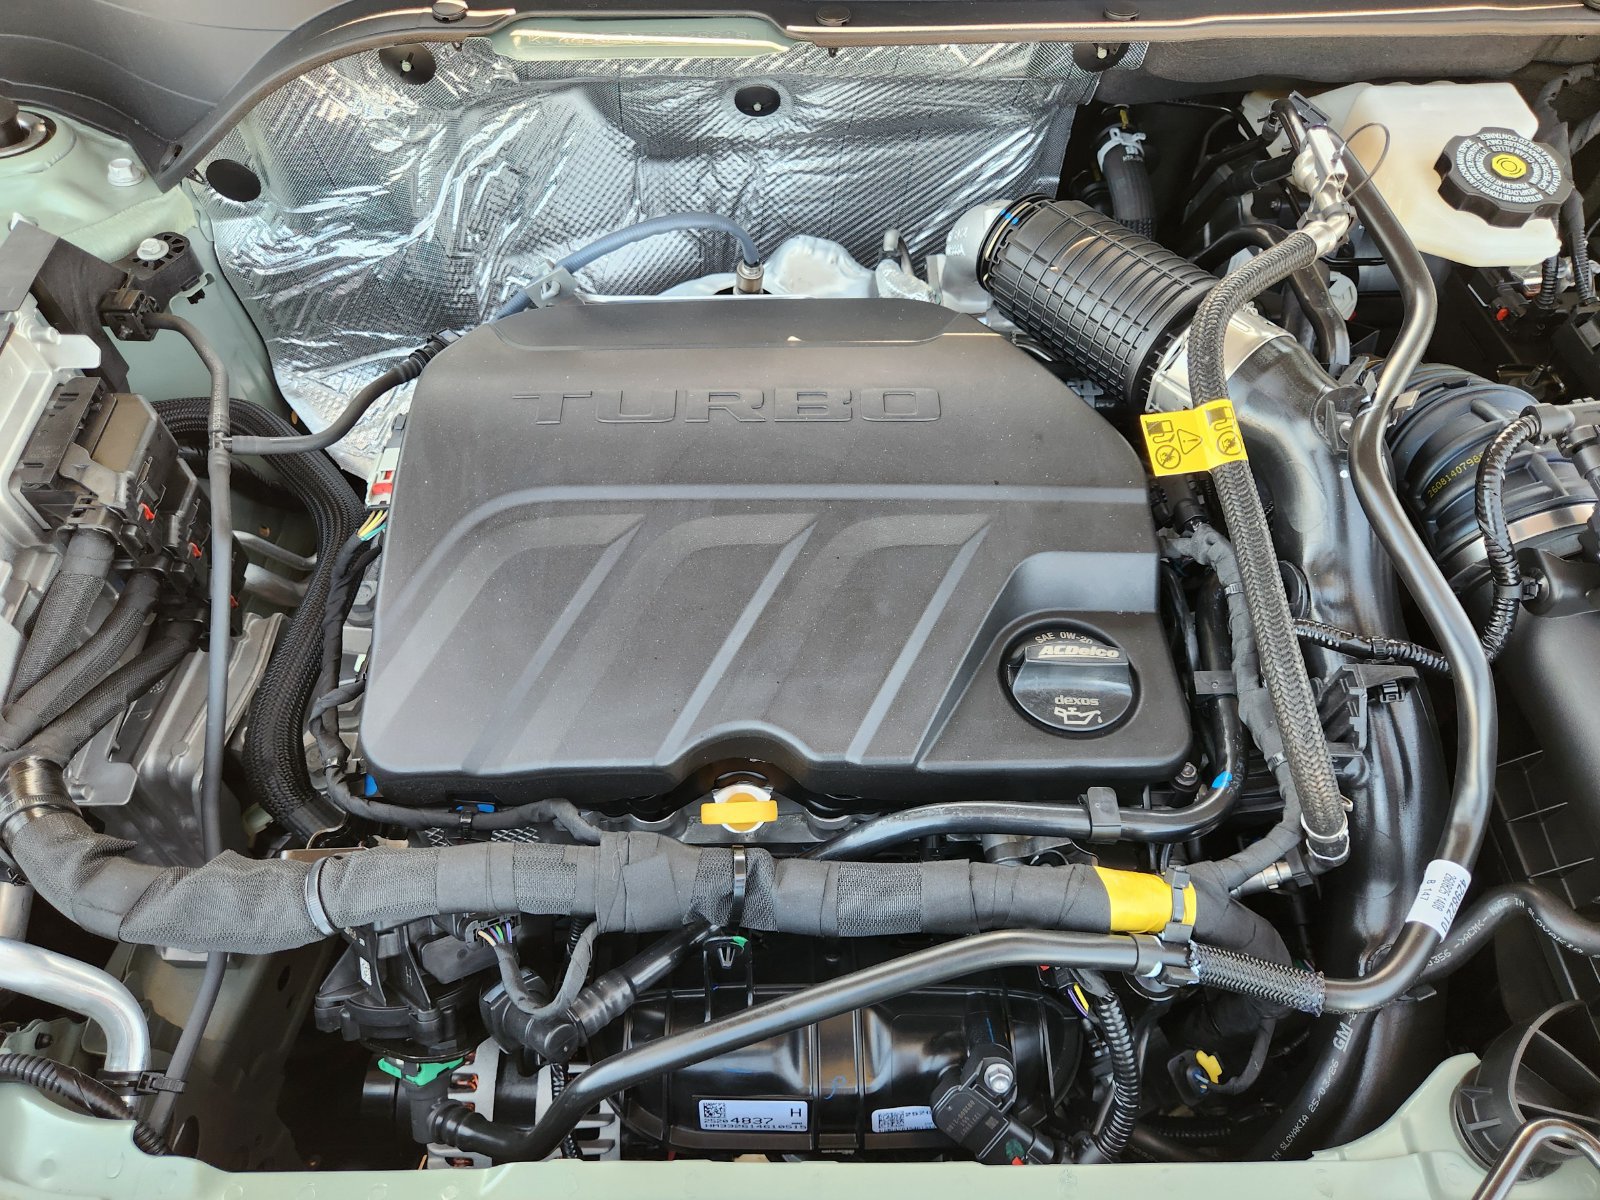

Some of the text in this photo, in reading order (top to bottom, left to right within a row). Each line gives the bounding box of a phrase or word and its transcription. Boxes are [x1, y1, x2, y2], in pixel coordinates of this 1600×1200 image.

[1489, 145, 1514, 153] FILLER
[1513, 148, 1536, 163] CLEAN
[512, 388, 941, 425] TURBO
[1035, 632, 1055, 644] SAE
[1039, 645, 1119, 659] ACDelco
[1054, 695, 1099, 706] dexos
[1514, 897, 1525, 908] IN
[1527, 907, 1584, 954] SLOVAKIA
[790, 1107, 802, 1118] H
[1280, 1113, 1310, 1150] SLOVAKIA
